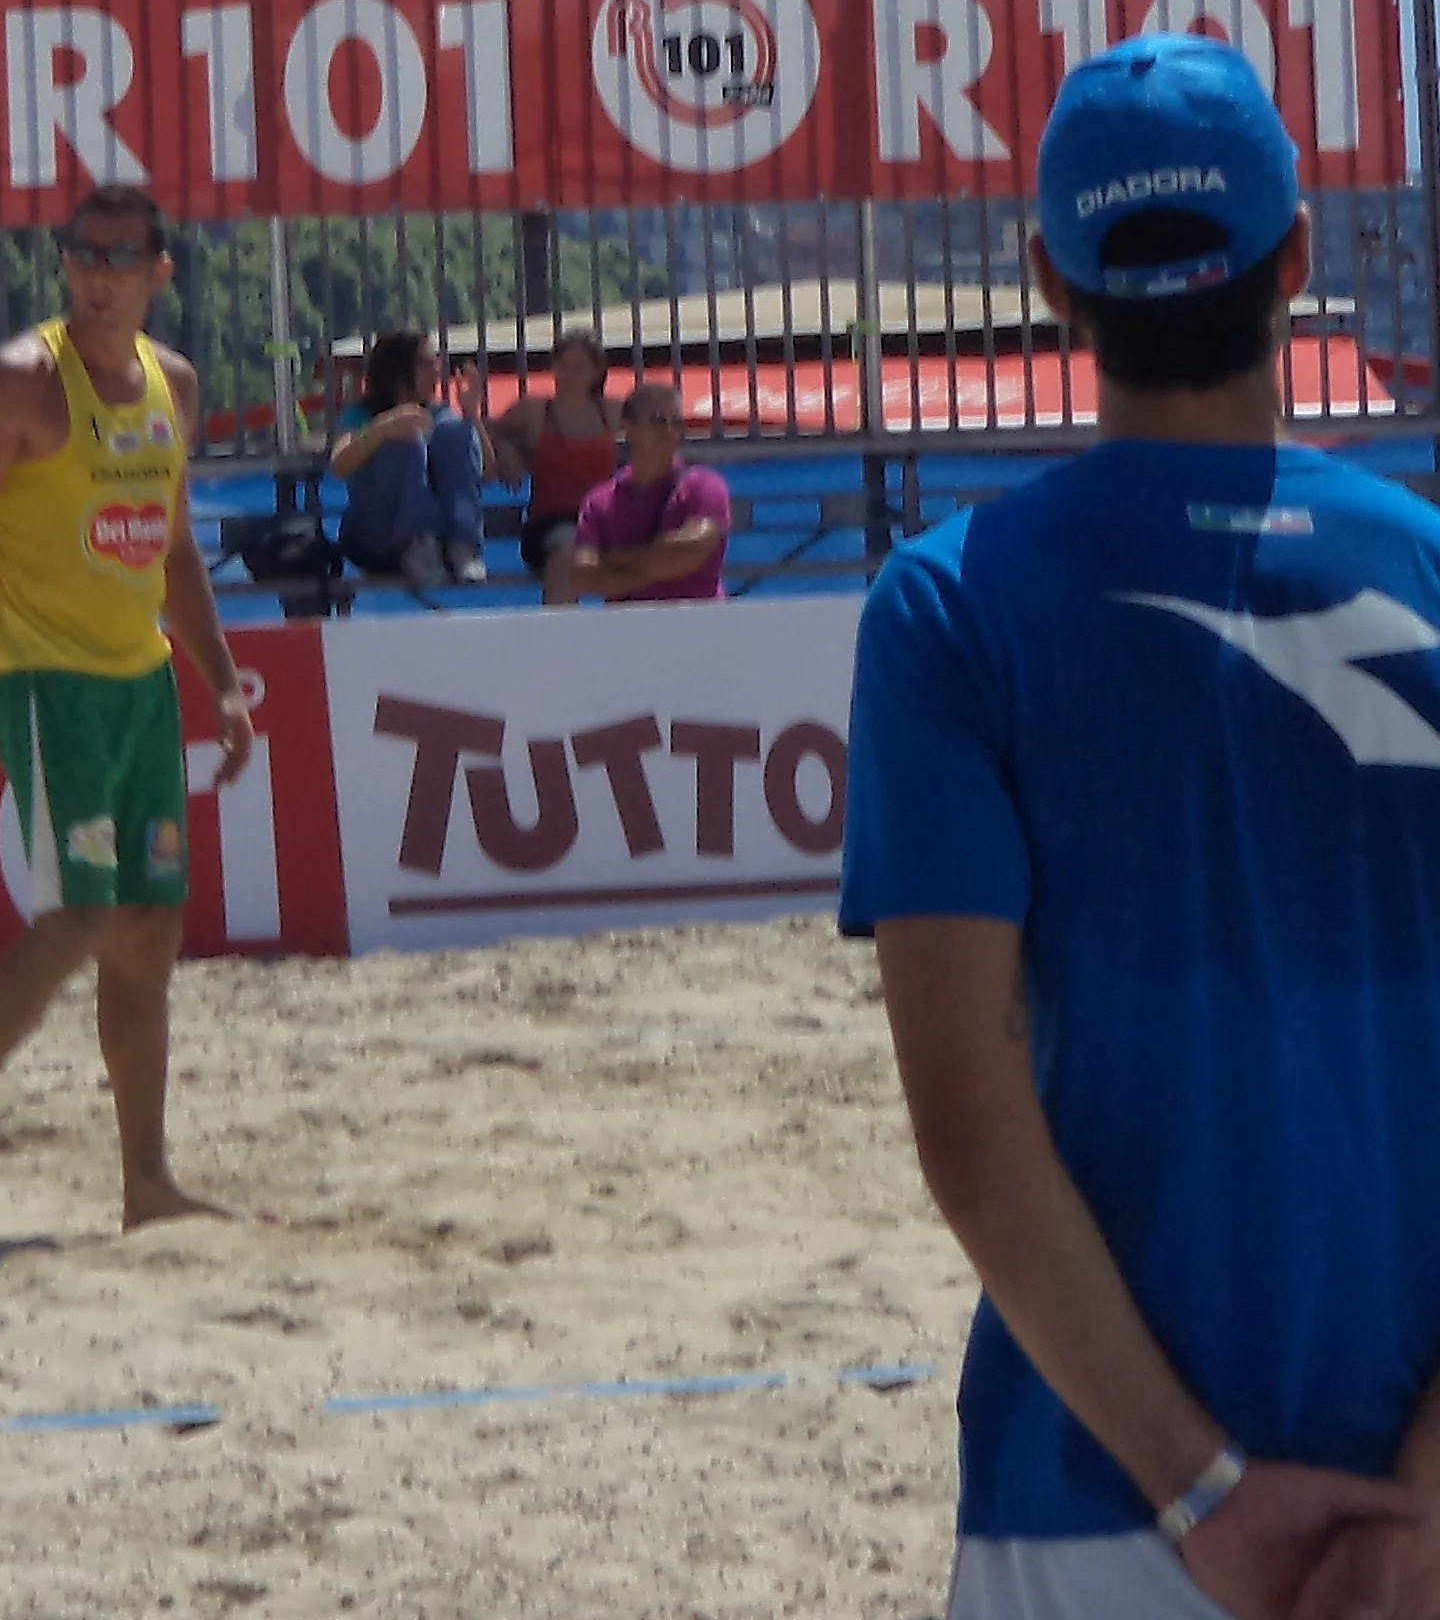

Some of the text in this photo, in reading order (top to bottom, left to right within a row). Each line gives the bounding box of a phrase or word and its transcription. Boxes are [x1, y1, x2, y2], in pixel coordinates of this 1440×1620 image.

[661, 34, 745, 74] 101
[1075, 165, 1227, 219] DIADORA
[372, 693, 848, 878] TUTTO
